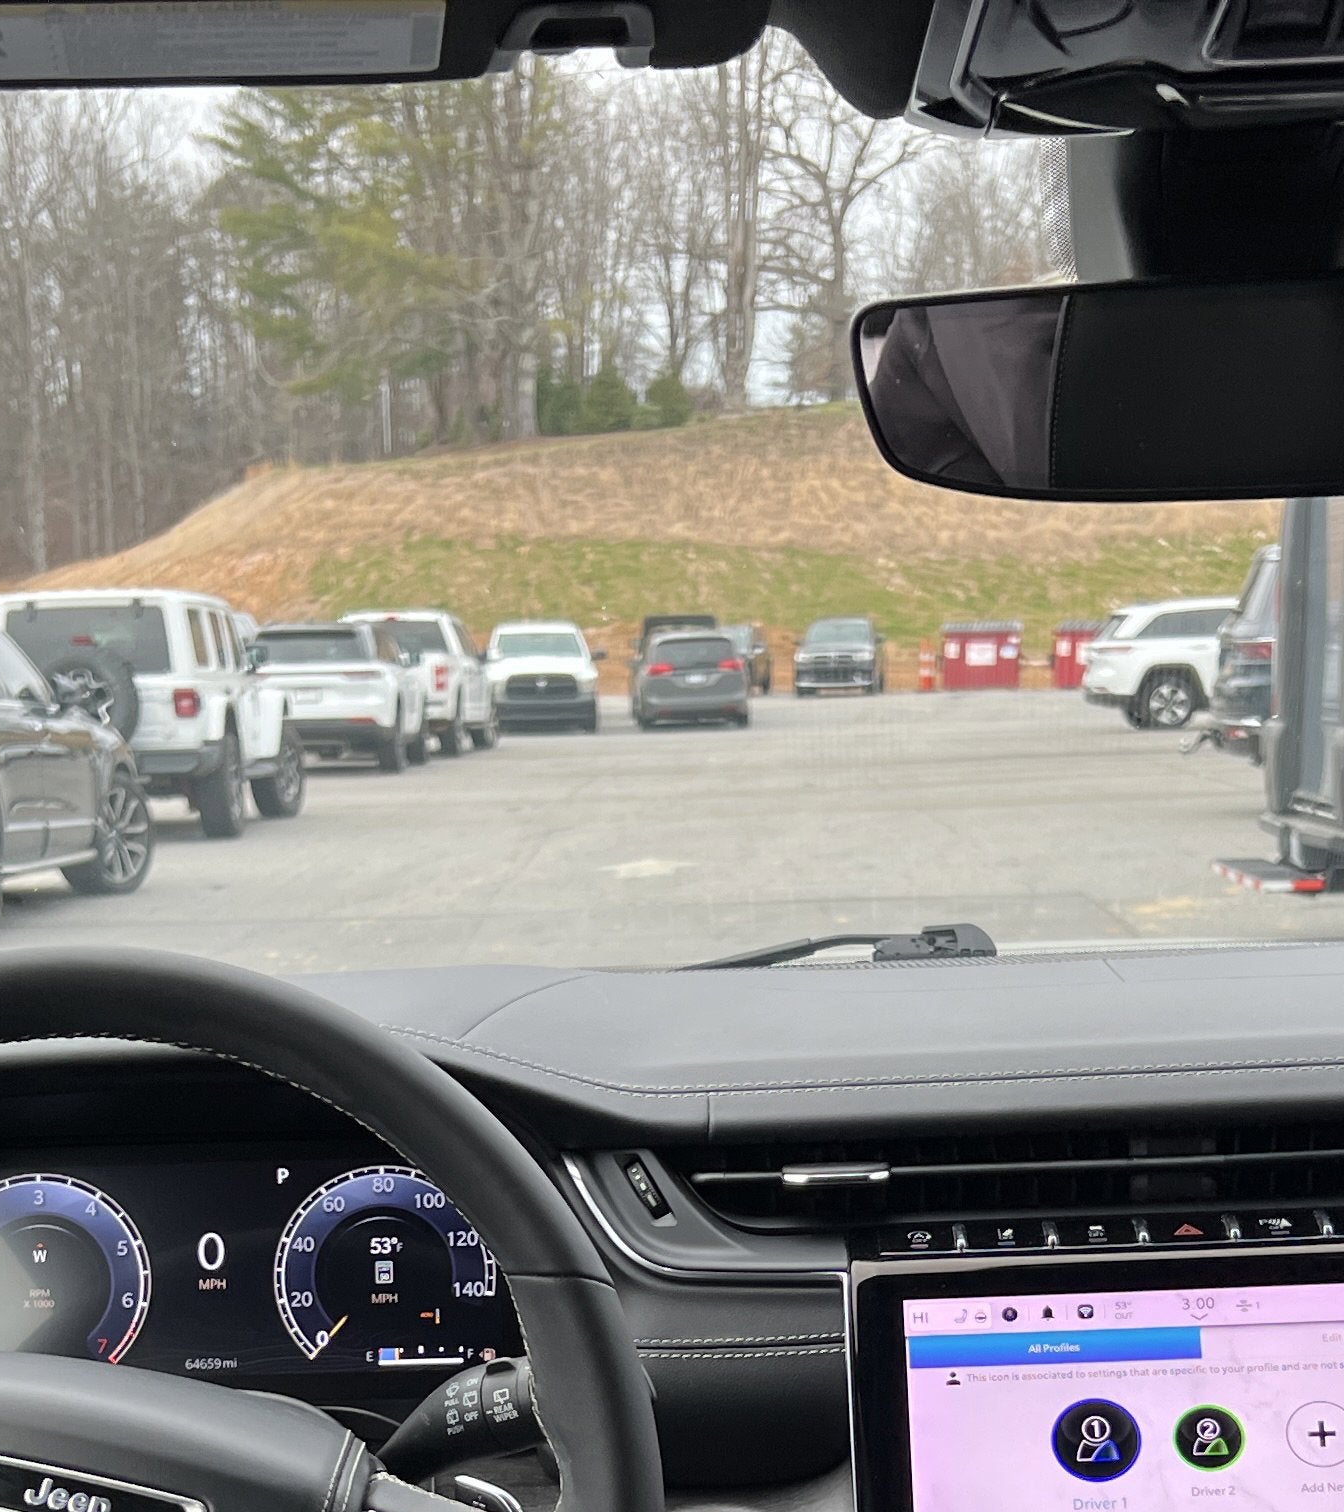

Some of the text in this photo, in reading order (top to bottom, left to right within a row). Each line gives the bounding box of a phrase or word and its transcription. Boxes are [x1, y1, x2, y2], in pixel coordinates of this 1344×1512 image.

[276, 1168, 290, 1185] P
[372, 1178, 396, 1194] 80
[33, 1189, 45, 1206] 3
[322, 1193, 446, 1213] 60 100
[84, 1202, 98, 1216] 4
[117, 1241, 129, 1256] 5
[292, 1231, 480, 1253] 40 120
[32, 1249, 48, 1263] W
[197, 1232, 226, 1271] 0
[198, 1278, 228, 1291] MPH
[29, 1288, 51, 1298] RPM
[121, 1293, 134, 1308] 6
[290, 1281, 485, 1308] 20 140
[371, 1293, 399, 1304] MPH
[33, 1300, 56, 1309] 1000
[314, 1330, 329, 1347] 0
[1321, 1332, 1343, 1342] Edit
[97, 1338, 109, 1353] 7
[1027, 1342, 1081, 1354] All Profiles
[366, 1347, 475, 1362] E F
[966, 1373, 987, 1382] This
[989, 1373, 1009, 1382] icon
[1022, 1370, 1073, 1380] associated
[1088, 1368, 1128, 1380] settings
[1129, 1367, 1150, 1377] that
[1152, 1368, 1167, 1376] are
[1170, 1365, 1206, 1377] specific
[1222, 1366, 1245, 1375] your
[1247, 1362, 1279, 1375] profile
[1281, 1361, 1300, 1371] and
[1302, 1362, 1318, 1370] are
[1320, 1361, 1338, 1370] not
[492, 1409, 519, 1423] WIPER
[493, 1402, 514, 1415] REAR
[463, 1411, 479, 1422] OFF
[1190, 1484, 1237, 1498] Driver 2
[1301, 1482, 1325, 1493] Add
[1072, 1496, 1128, 1512] Driver 1
